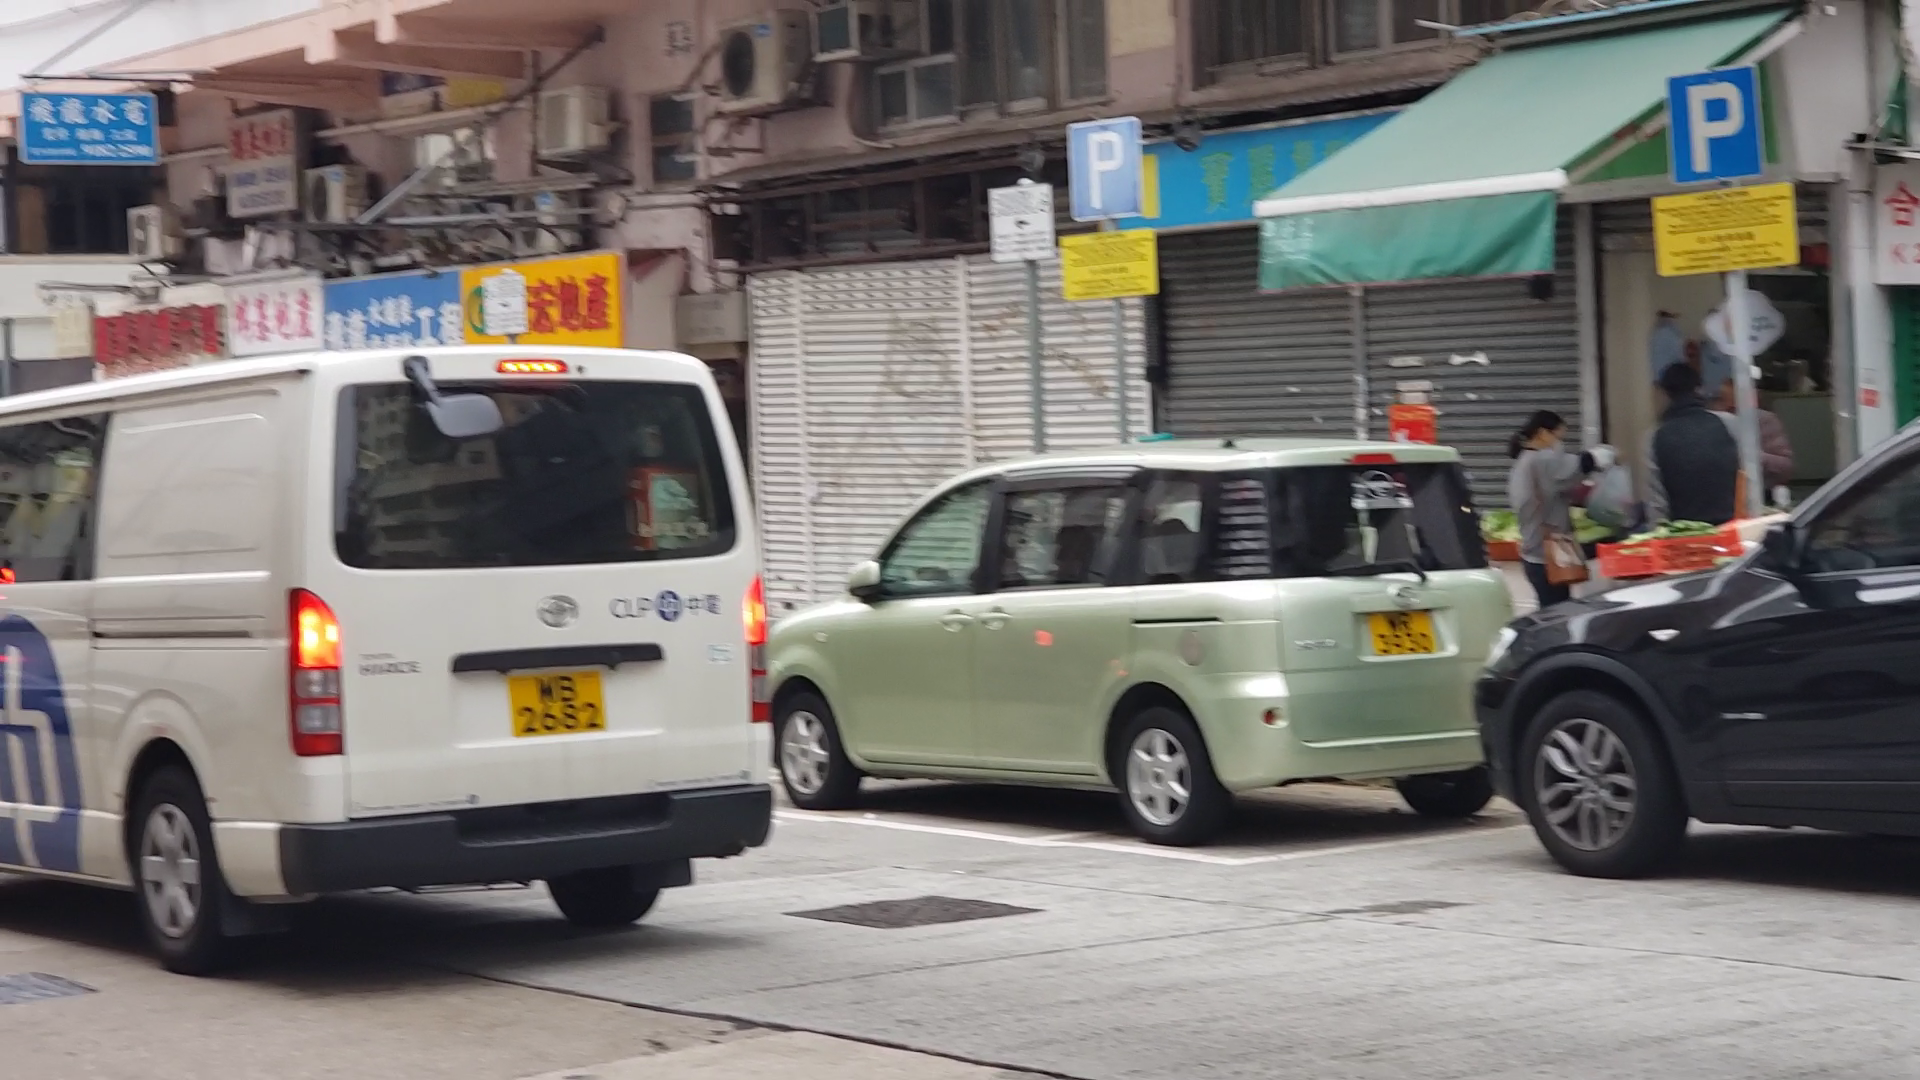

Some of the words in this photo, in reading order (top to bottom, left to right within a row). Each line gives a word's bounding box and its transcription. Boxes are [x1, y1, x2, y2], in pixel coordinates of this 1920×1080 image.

[1685, 81, 1745, 173] P
[1086, 131, 1124, 209] P
[609, 596, 653, 618] CLP
[516, 702, 602, 733] 2682
